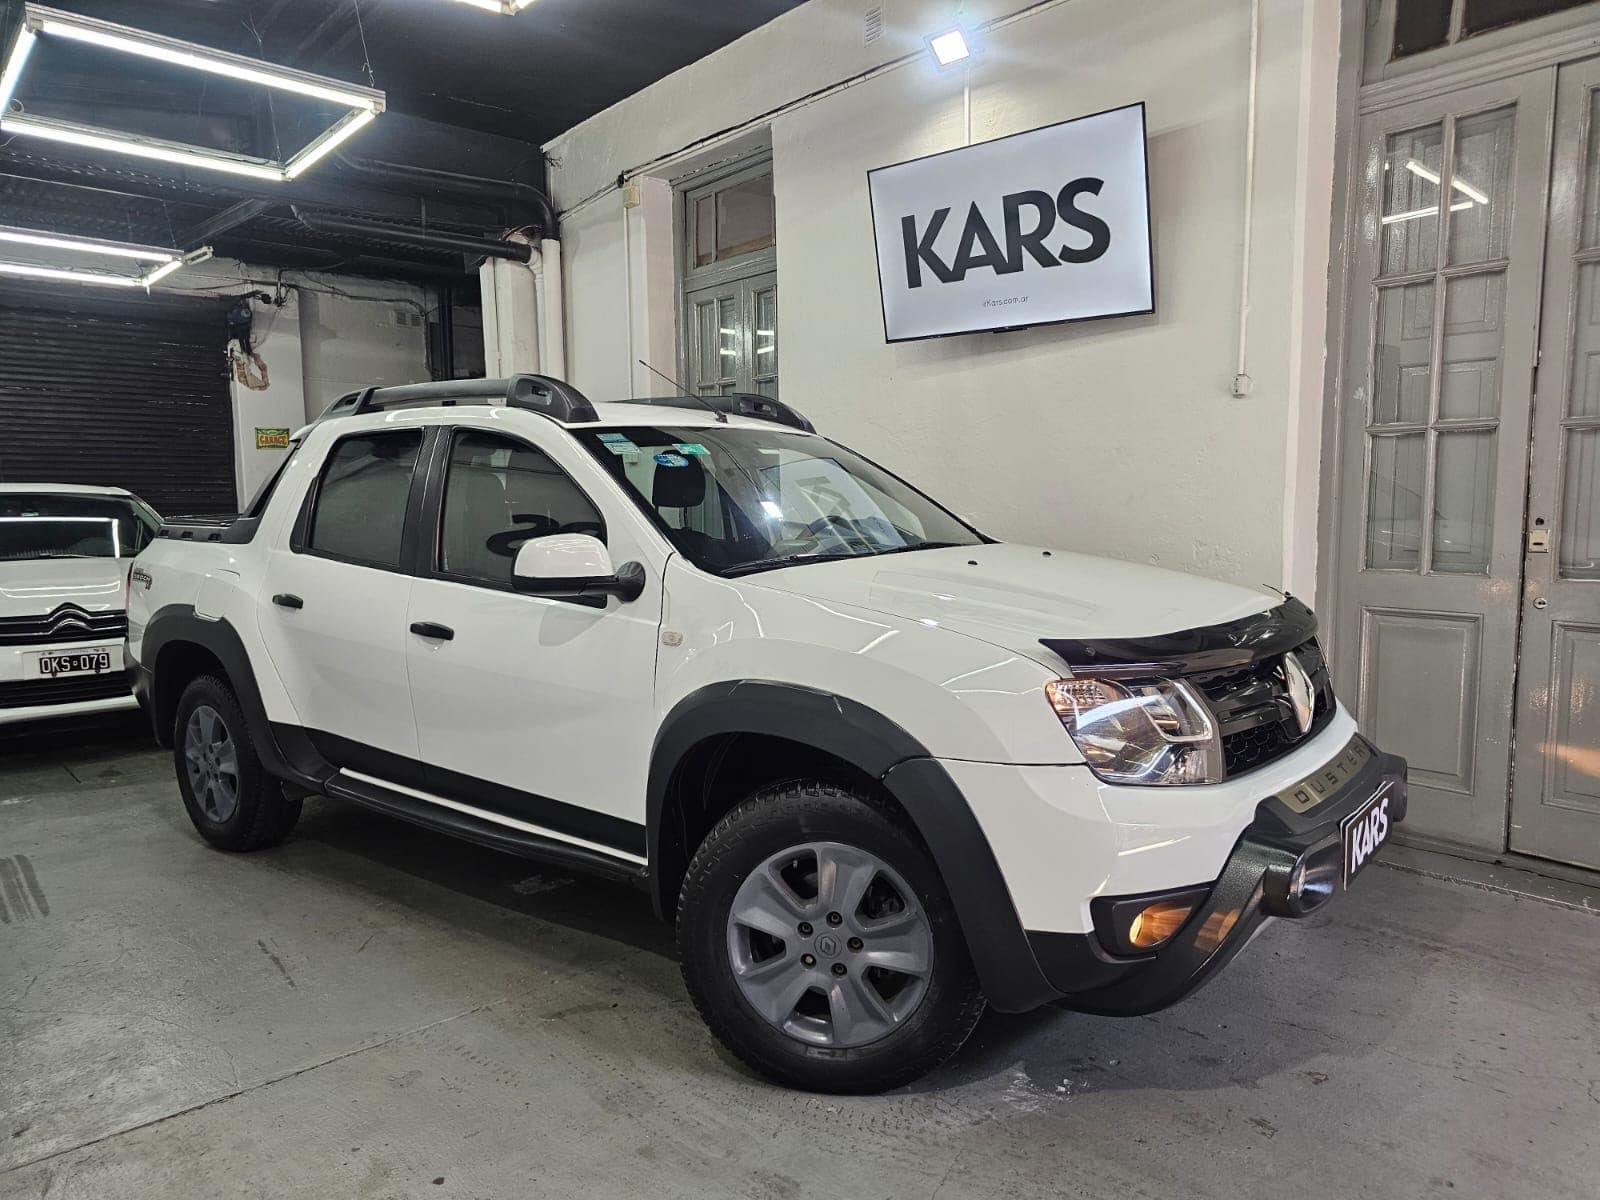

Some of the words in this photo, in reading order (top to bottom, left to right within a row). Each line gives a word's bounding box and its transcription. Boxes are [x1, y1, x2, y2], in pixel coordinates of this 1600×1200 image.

[901, 177, 1111, 288] KARS
[259, 435, 287, 445] GARAGE
[42, 657, 71, 673] OKS
[81, 654, 108, 670] 079
[1351, 798, 1389, 874] KARS
